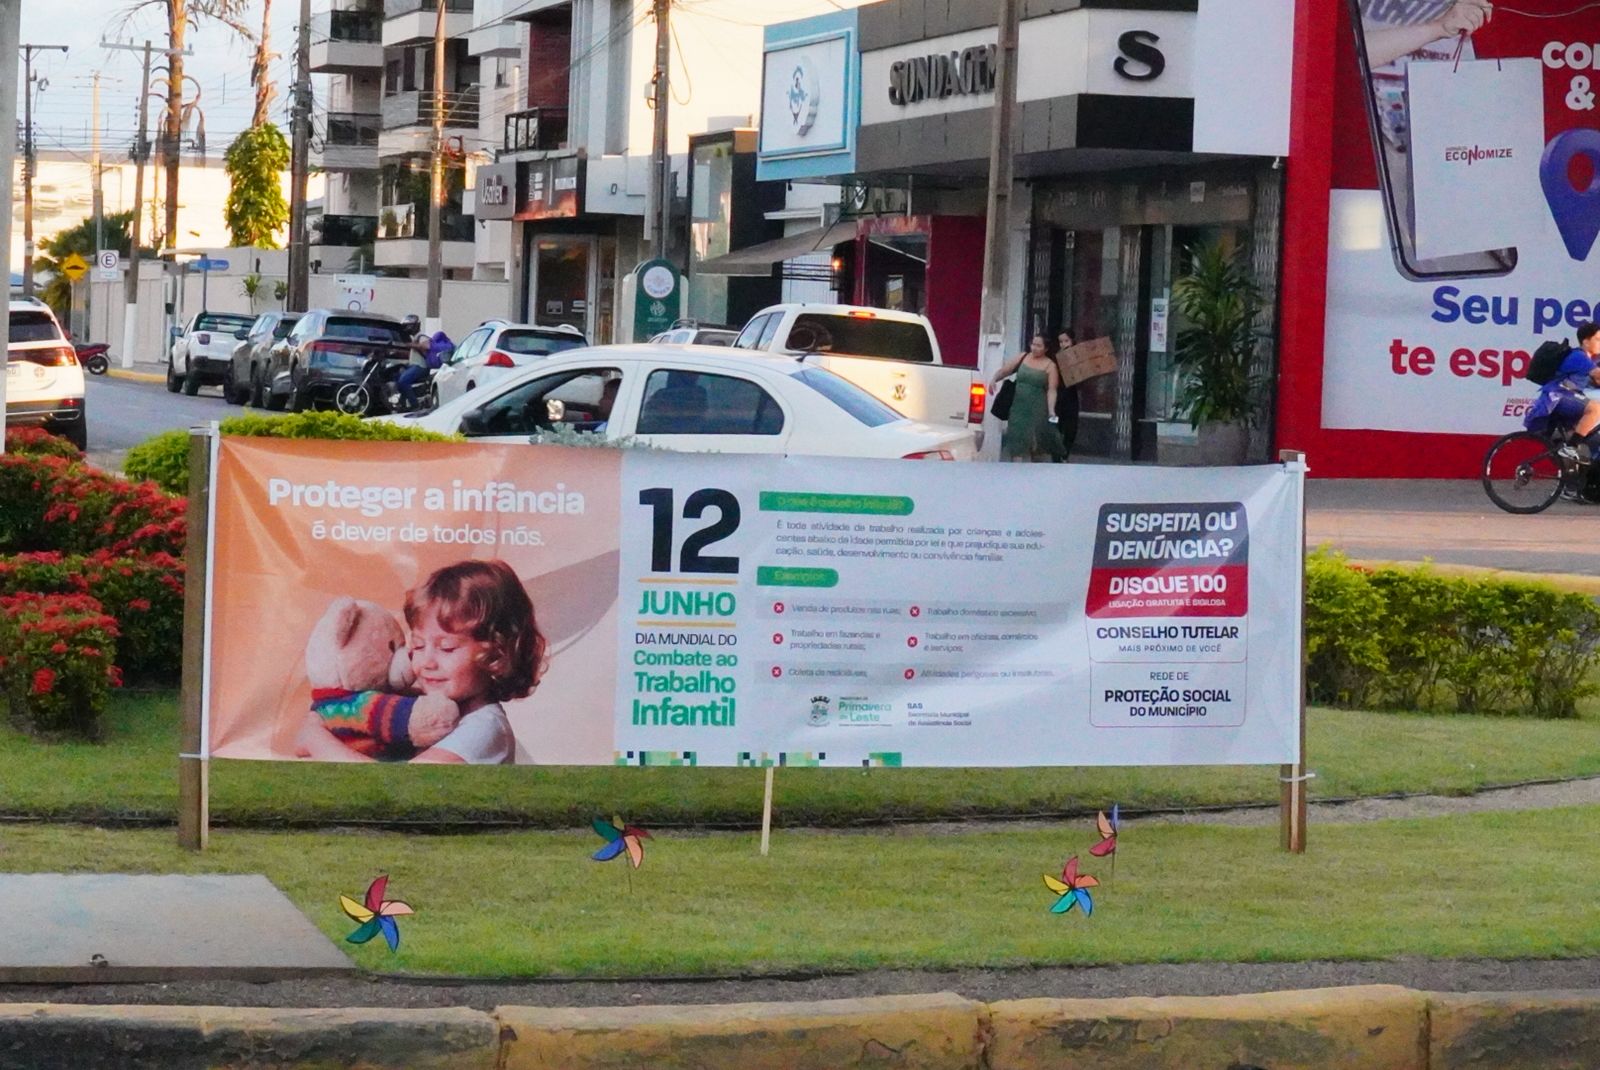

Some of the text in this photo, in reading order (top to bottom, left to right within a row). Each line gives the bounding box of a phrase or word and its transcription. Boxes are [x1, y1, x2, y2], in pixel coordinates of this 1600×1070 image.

[1113, 30, 1166, 81] S
[1565, 75, 1596, 111] &
[1445, 145, 1513, 165] ECONOMIZE
[105, 255, 113, 265] E
[1431, 285, 1519, 326] Seu
[1389, 339, 1532, 386] te esp
[268, 478, 585, 517] Proteger a infância
[639, 488, 741, 574] 12
[786, 521, 807, 530] toda
[810, 521, 850, 531] atividade
[854, 522, 866, 532] de
[869, 523, 904, 533] trabalho
[1105, 511, 1237, 533] SUSPEITA OU
[312, 520, 545, 546] é dever de todos nós.
[1107, 534, 1234, 561] DENÚNCIA?
[1108, 574, 1227, 595] DISQUE 100
[637, 590, 737, 617] JUNHO
[635, 633, 738, 646] DIA MUNDIAL DO
[1096, 626, 1239, 640] CONSELHO TUTELAR
[633, 649, 738, 667] Combate ao
[1118, 643, 1222, 653] MAIS PRÓXIMO DE VOCÊ
[633, 670, 736, 694] Trabalho
[1150, 671, 1190, 681] REDE DE
[1104, 686, 1231, 705] PROTEÇÃO SOCIAL
[632, 696, 736, 727] Infantil
[838, 701, 892, 712] Primavera
[850, 712, 881, 722] Leste
[1129, 704, 1207, 717] DO MUNICÍPIO
